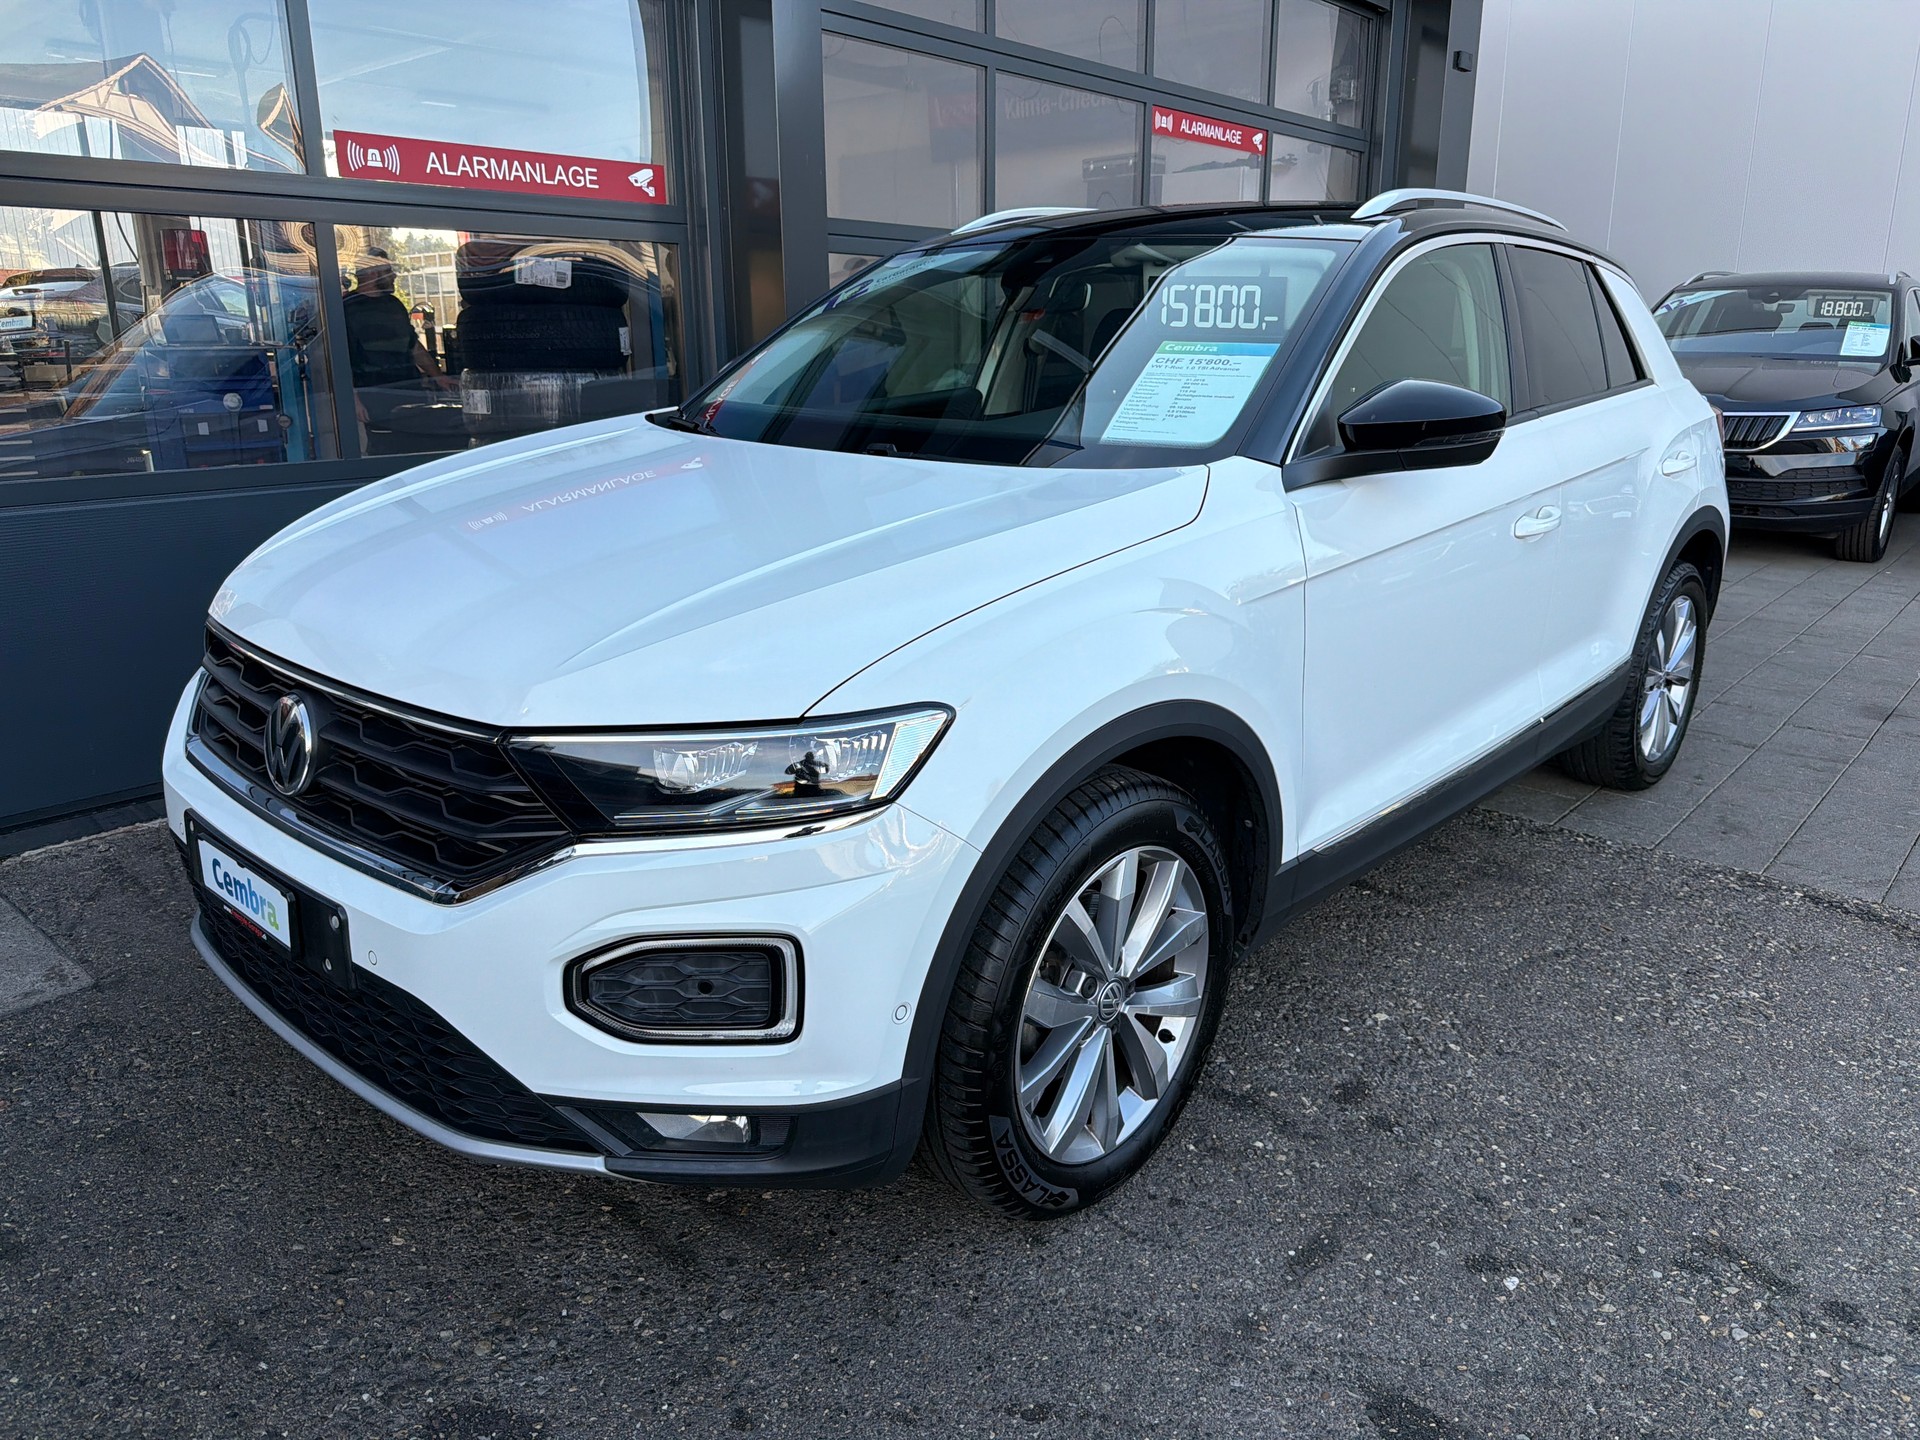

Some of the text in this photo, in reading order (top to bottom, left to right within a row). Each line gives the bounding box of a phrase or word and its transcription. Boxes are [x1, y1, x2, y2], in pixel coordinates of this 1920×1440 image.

[1180, 118, 1242, 145] ALARMANLAGE
[426, 151, 599, 189] ALARMANLAGE
[1155, 357, 1184, 366] CHF
[1164, 343, 1218, 353] Cembra
[211, 858, 280, 931] Cembra
